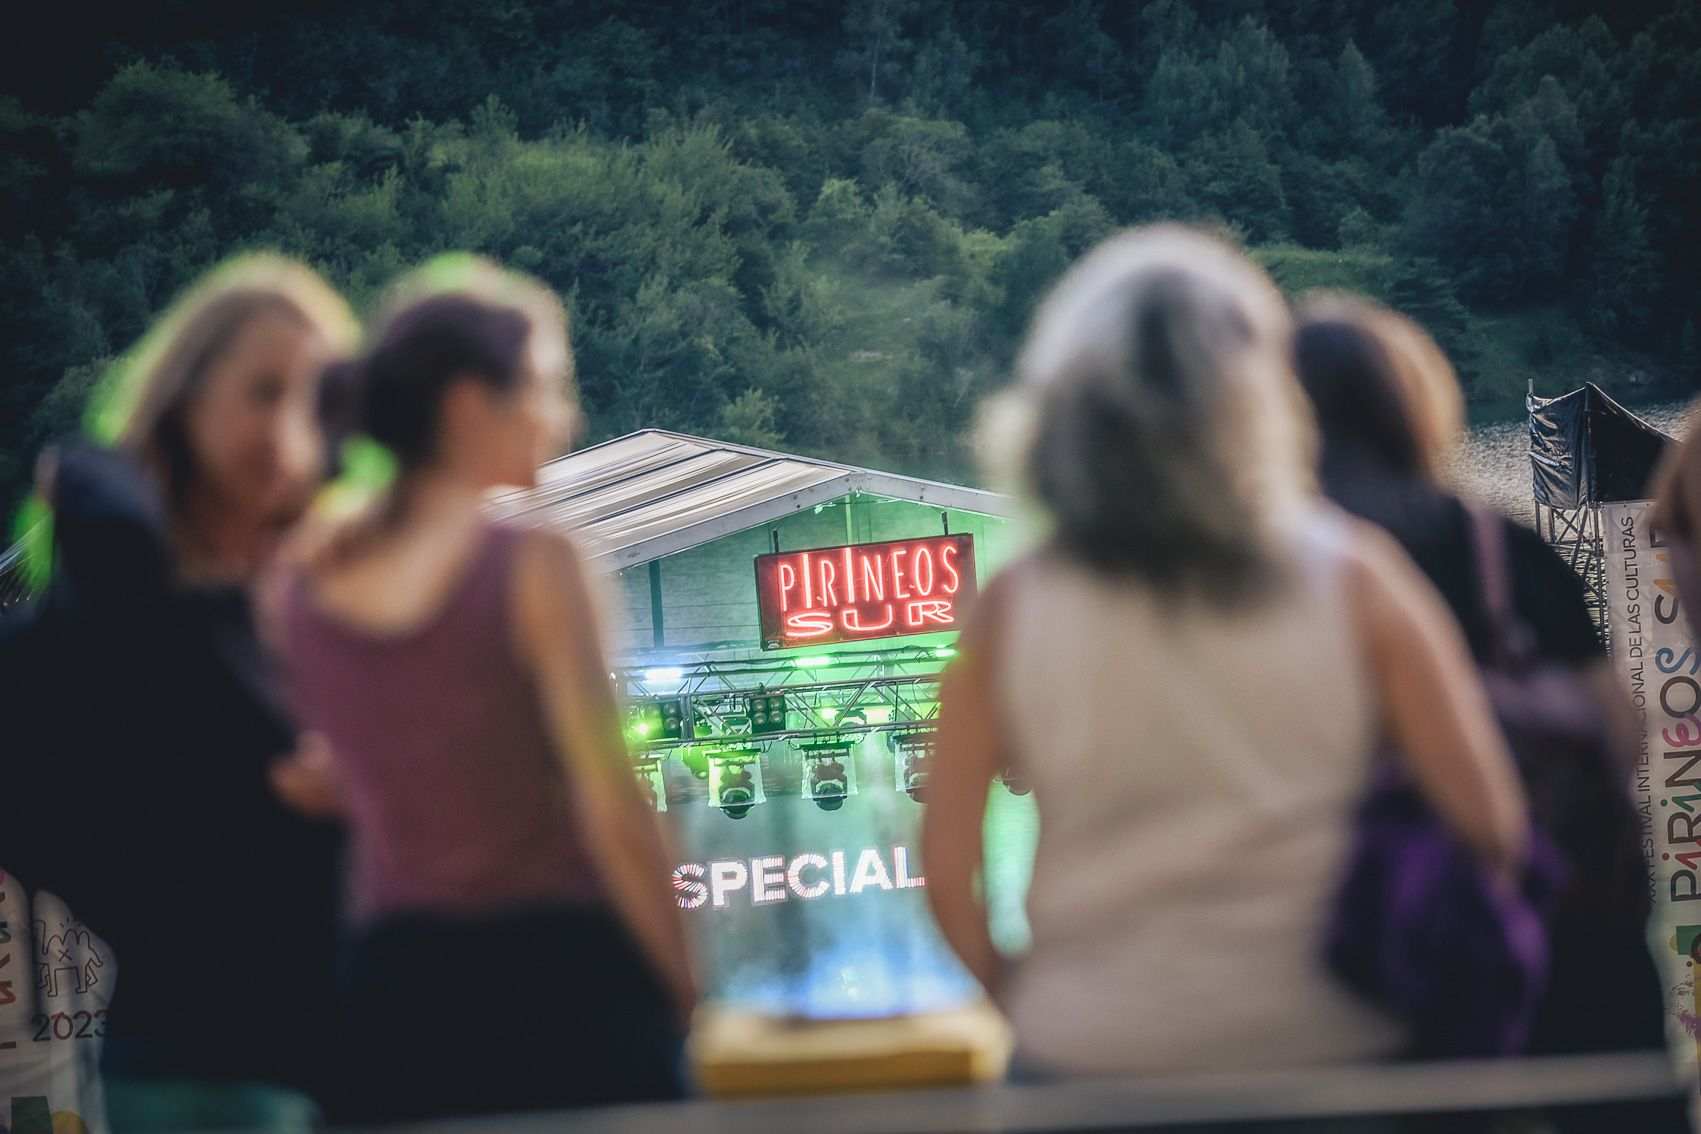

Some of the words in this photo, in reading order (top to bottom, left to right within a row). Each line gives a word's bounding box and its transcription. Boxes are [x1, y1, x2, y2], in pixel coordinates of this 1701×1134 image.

[779, 546, 960, 612] PIRINEOS
[1620, 516, 1641, 601] CULTURAS
[785, 600, 955, 637] SUR
[1627, 603, 1642, 637] LAS
[1629, 636, 1643, 658] DE
[671, 845, 926, 909] SPECIAL
